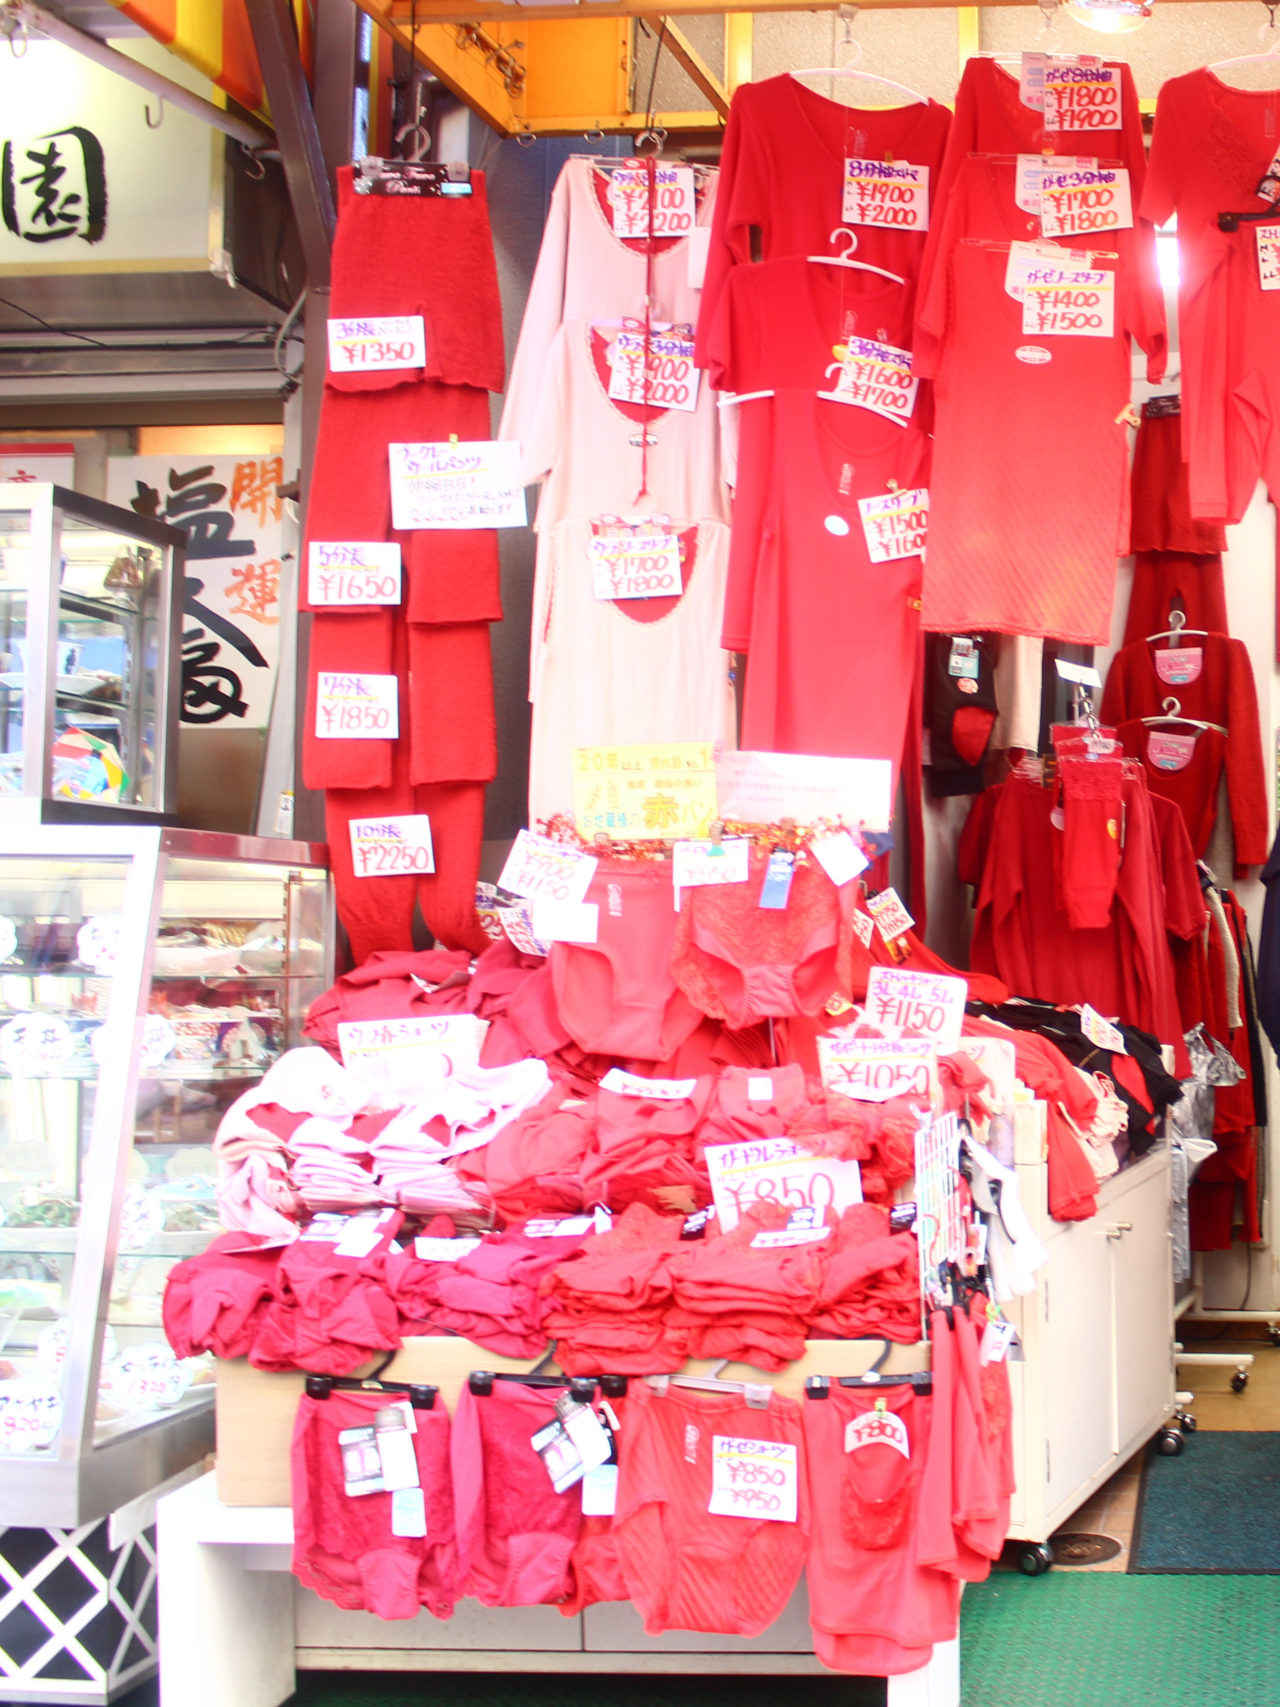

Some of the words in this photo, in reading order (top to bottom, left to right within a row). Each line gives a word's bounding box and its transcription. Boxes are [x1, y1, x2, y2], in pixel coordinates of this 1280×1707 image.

[1053, 85, 1117, 109] ¥1800
[1055, 108, 1117, 129] ¥1900
[2, 126, 108, 246] 園
[855, 180, 915, 203] ¥1900
[1049, 188, 1114, 213] ¥1700
[855, 202, 917, 225] ¥2000
[1054, 210, 1119, 235] ¥1800
[1036, 290, 1100, 312] ¥1400
[1037, 312, 1103, 332] ¥1500
[341, 341, 416, 364] ¥1350
[626, 354, 689, 381] ¥900
[854, 361, 914, 389] ¥1600
[852, 380, 908, 410] ¥1700
[872, 509, 928, 538] ¥1500
[229, 456, 284, 626] 開運
[605, 555, 669, 578] ¥1700
[317, 575, 398, 601] ¥1650
[609, 574, 674, 596] ¥1800
[321, 704, 390, 733] ¥1850
[357, 846, 430, 874] ¥2250
[876, 996, 946, 1033] ¥1150
[838, 1061, 931, 1099] ¥1050
[718, 1144, 798, 1168] ガードルショ
[723, 1171, 836, 1211] ¥850
[727, 1462, 787, 1487] ¥850
[730, 1487, 782, 1512] ¥950
